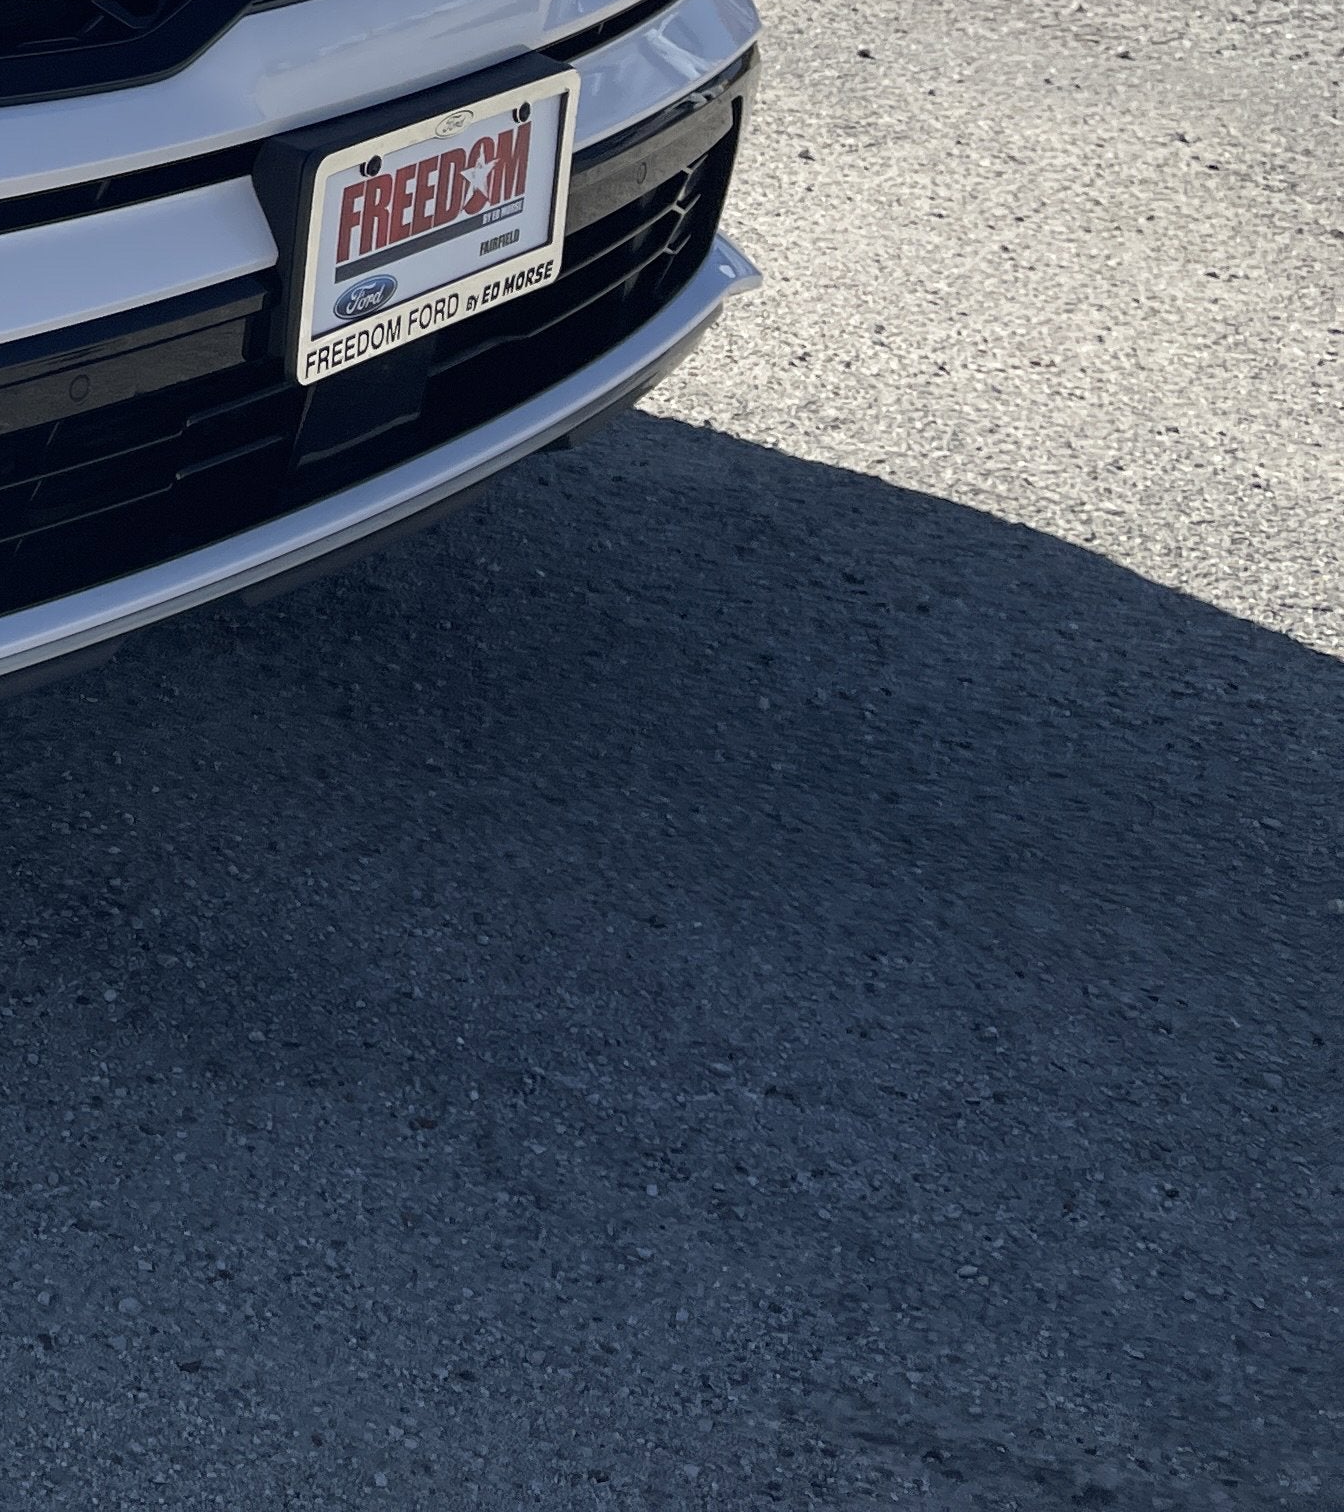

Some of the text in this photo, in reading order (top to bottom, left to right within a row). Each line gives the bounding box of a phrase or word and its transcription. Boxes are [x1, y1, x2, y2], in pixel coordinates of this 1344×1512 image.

[336, 121, 531, 264] FREEDOM
[305, 315, 402, 379] FREEDOM
[408, 293, 459, 335] FORD
[481, 281, 500, 305] ED
[502, 259, 554, 296] MORSE
[346, 282, 386, 314] Ford
